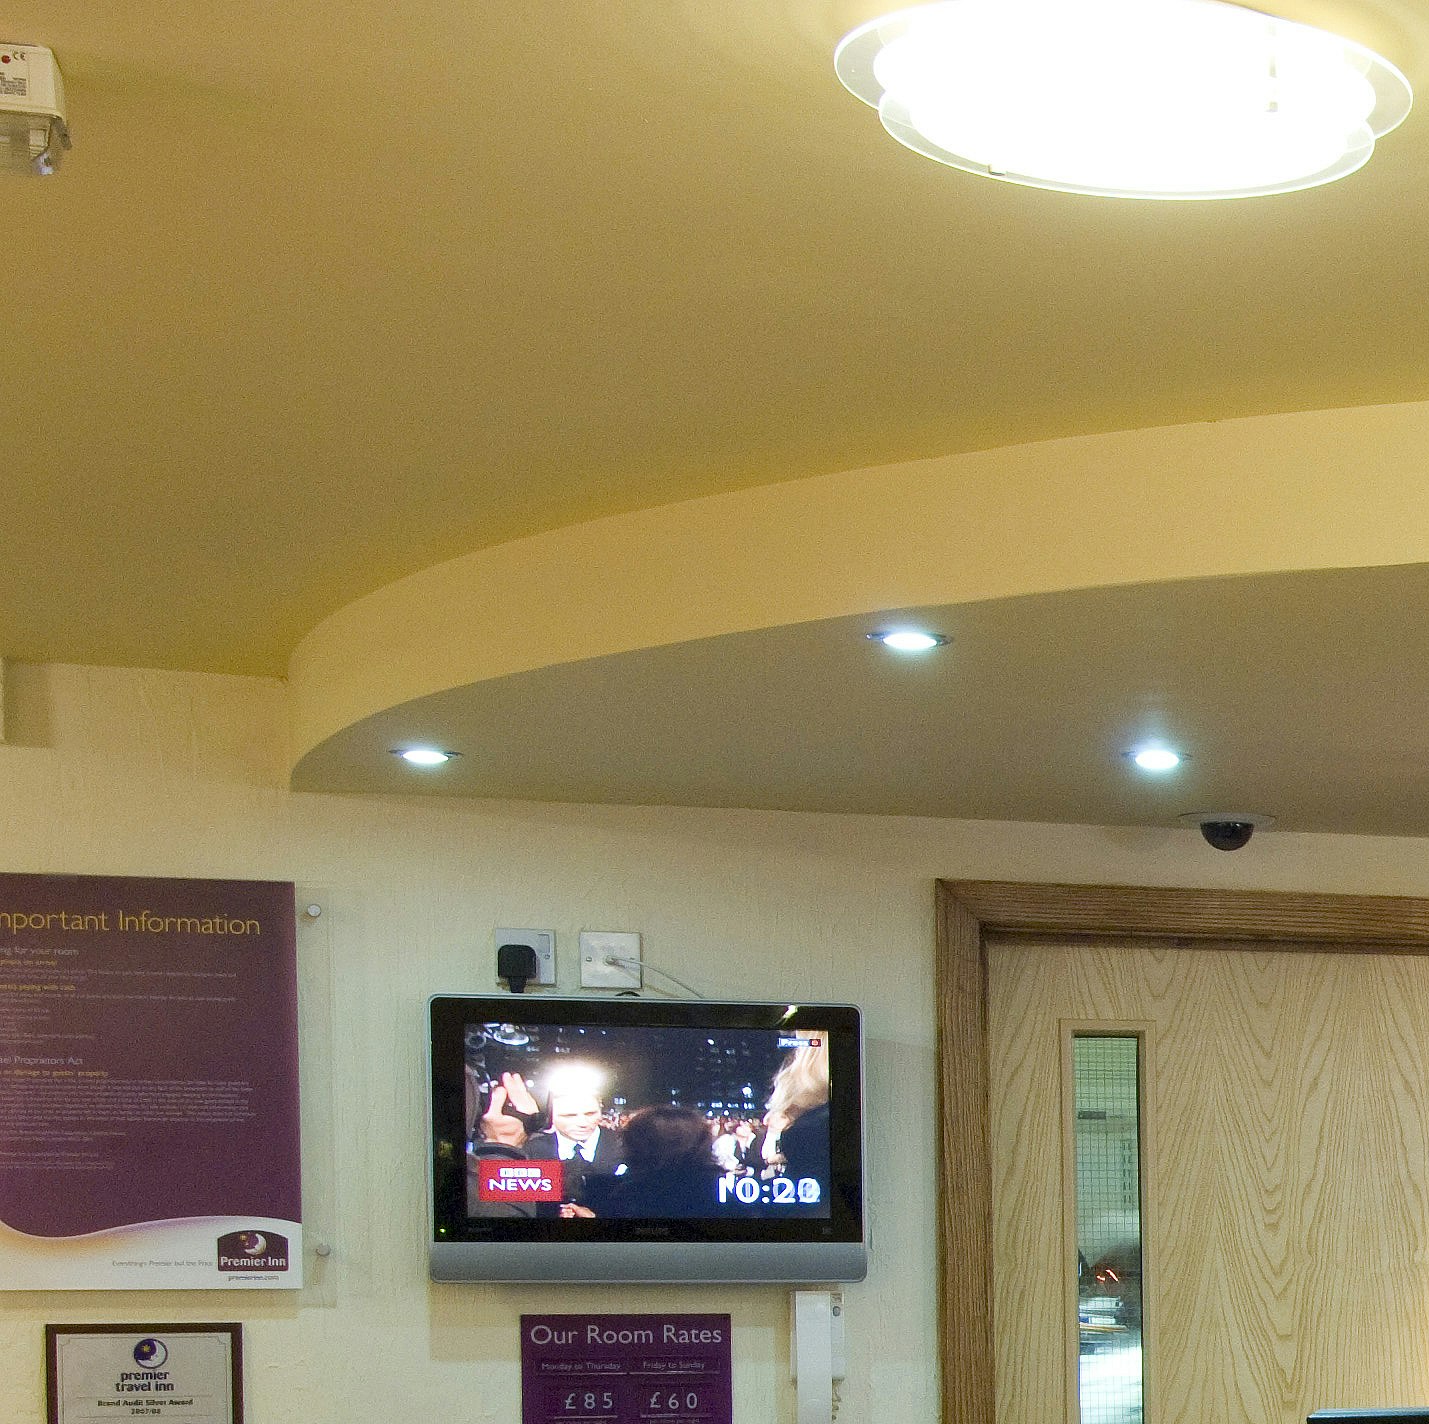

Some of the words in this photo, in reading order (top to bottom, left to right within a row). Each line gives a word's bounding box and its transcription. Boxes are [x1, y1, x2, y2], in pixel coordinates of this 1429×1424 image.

[0, 910, 110, 935] portant
[118, 909, 261, 935] Information
[488, 1178, 553, 1192] NEWS
[220, 1256, 266, 1267] Premier
[268, 1256, 287, 1267] Inn
[530, 1324, 578, 1345] Our
[587, 1324, 654, 1345] Room
[663, 1323, 723, 1344] Rates
[541, 1362, 572, 1371] Monday
[586, 1361, 621, 1371] Thursday
[643, 1361, 666, 1371] Friday
[679, 1361, 706, 1370] Sunday
[120, 1369, 170, 1383] premier
[115, 1380, 151, 1392] travel
[155, 1380, 175, 1392] inn
